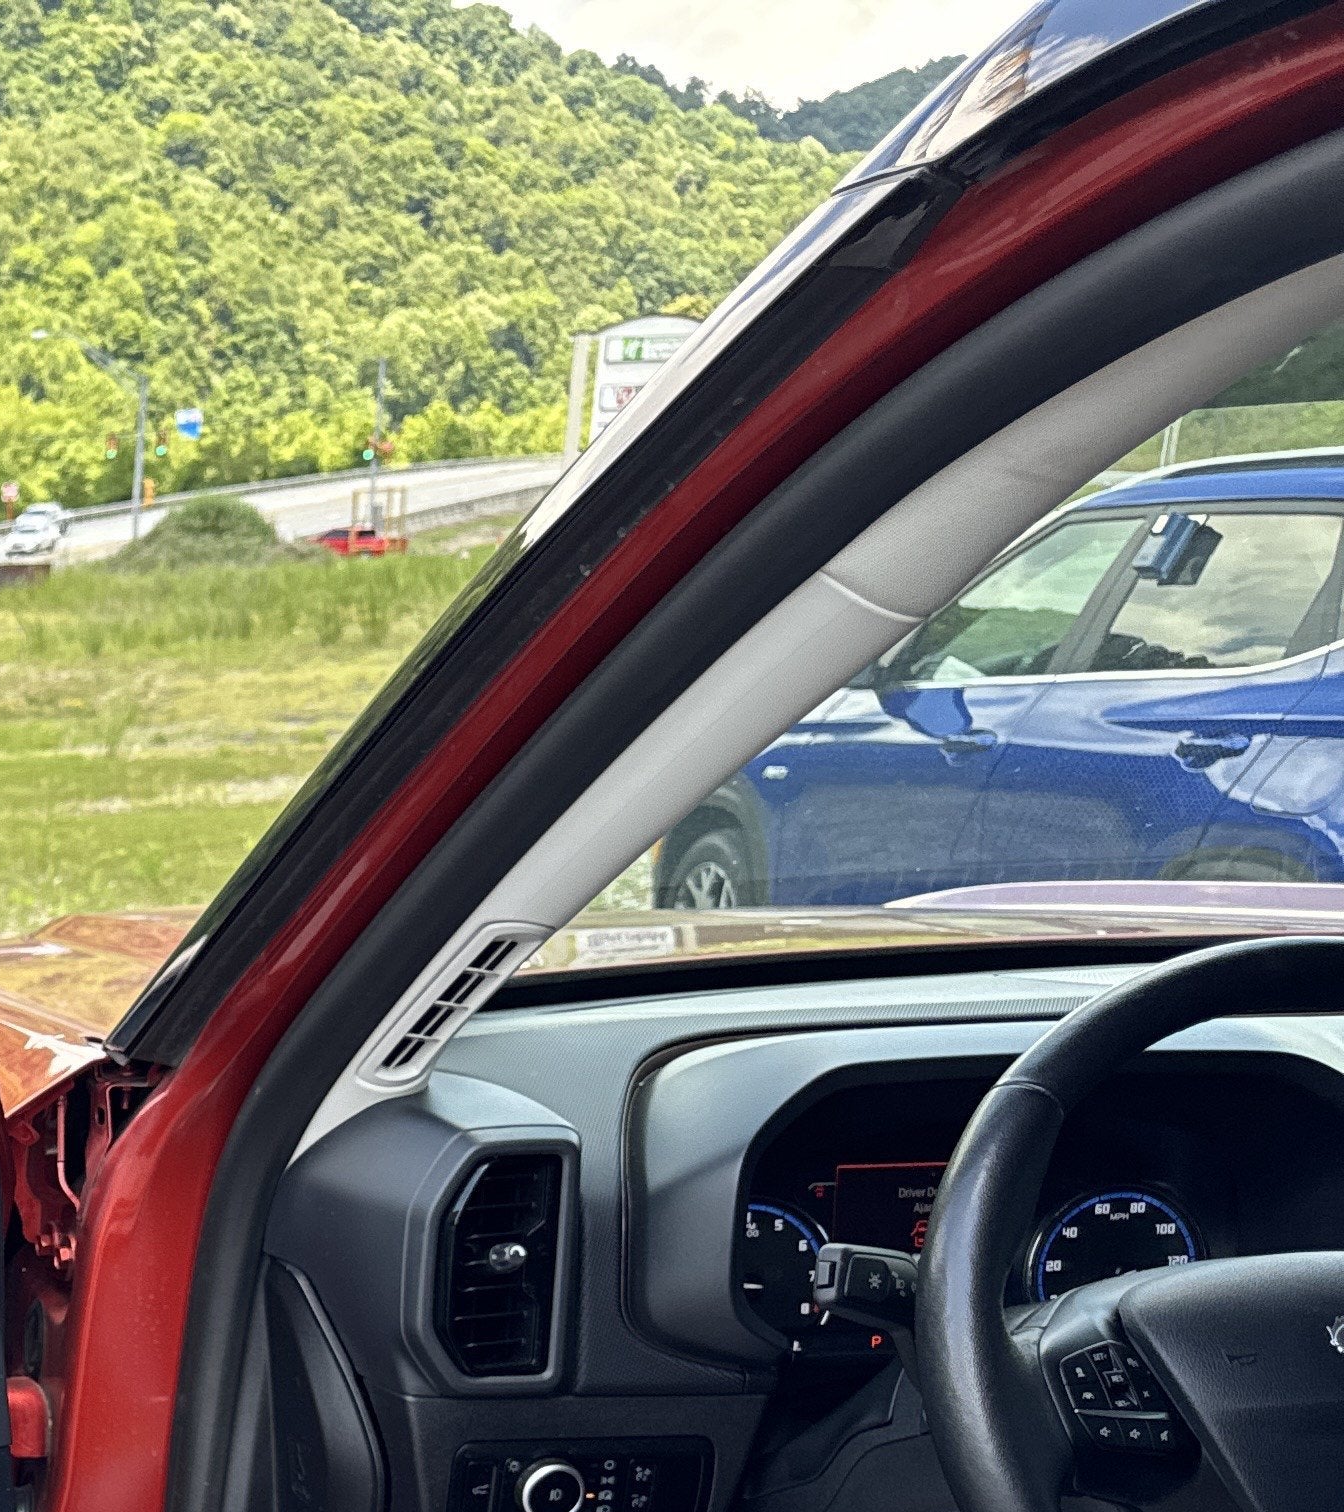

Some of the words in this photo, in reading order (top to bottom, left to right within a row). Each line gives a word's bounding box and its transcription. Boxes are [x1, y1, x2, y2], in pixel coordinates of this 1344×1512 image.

[898, 1186, 926, 1198] Driver
[1094, 1203, 1111, 1215] 60
[1130, 1202, 1146, 1214] 80
[1109, 1212, 1129, 1221] MPH
[774, 1219, 784, 1231] 5
[1155, 1222, 1176, 1235] 100
[1062, 1226, 1078, 1239] 40
[798, 1239, 808, 1251] 6
[1045, 1260, 1062, 1272] 20
[1168, 1255, 1188, 1266] 120
[871, 1335, 882, 1349] P
